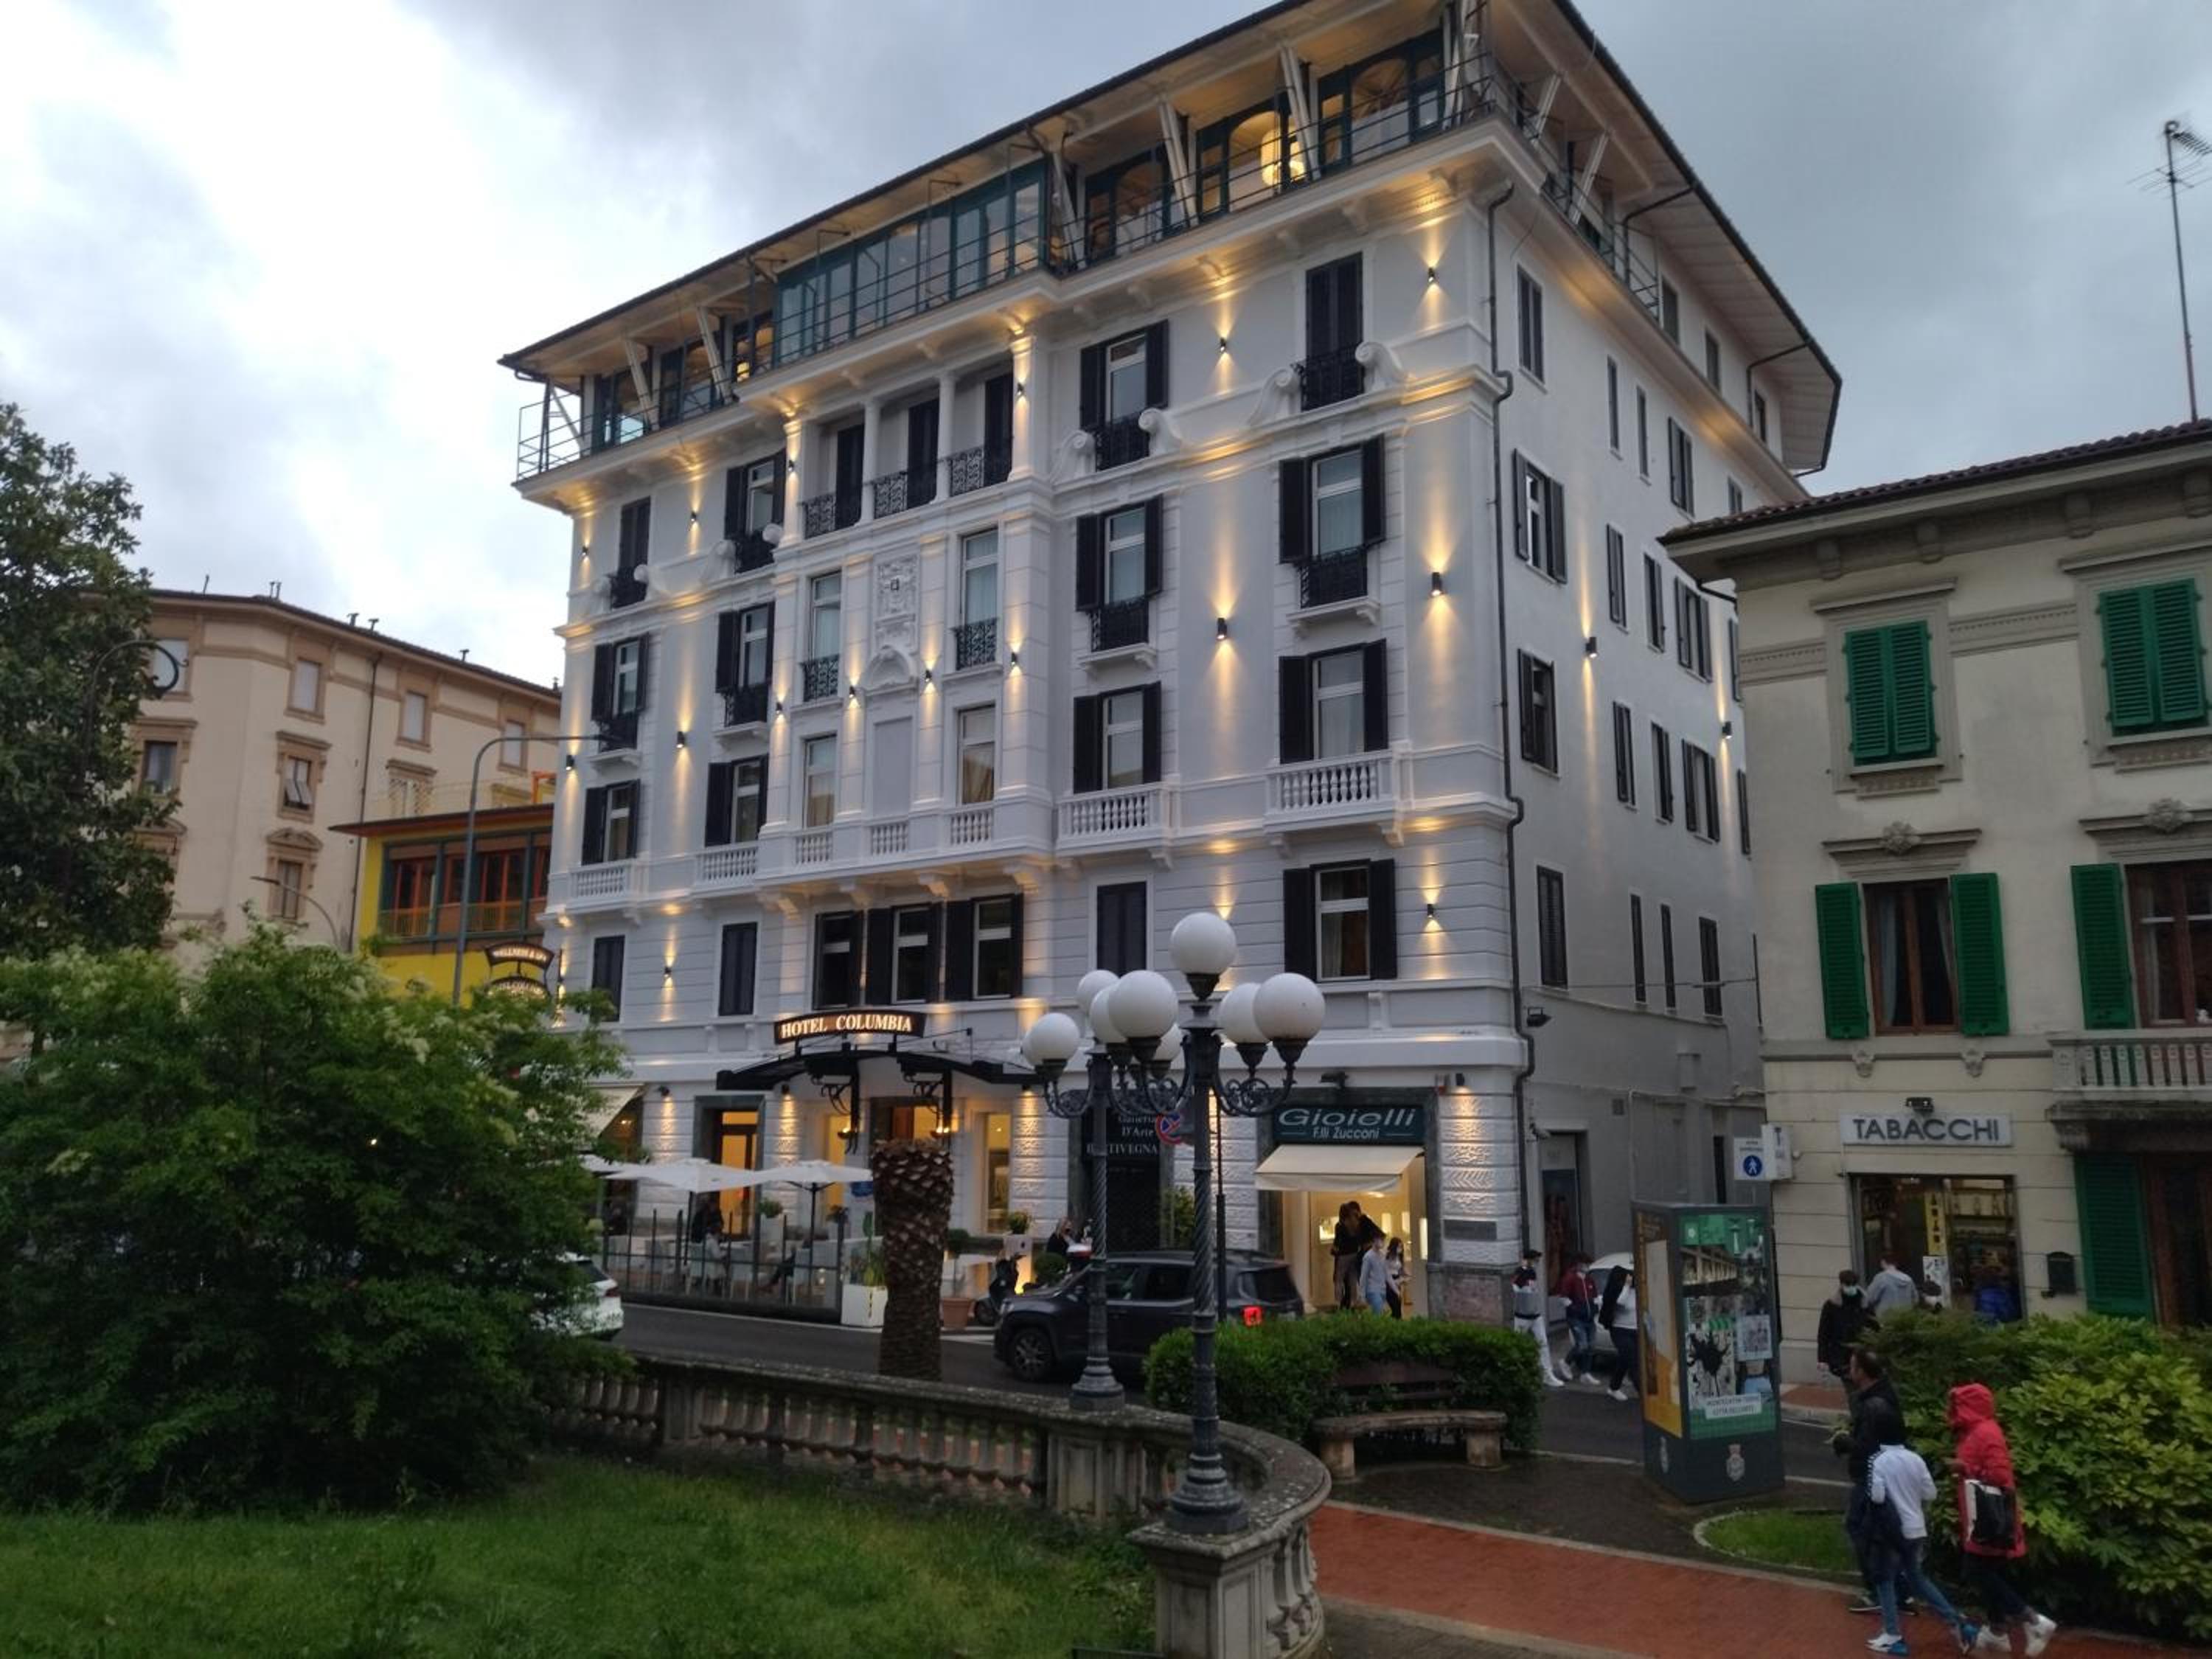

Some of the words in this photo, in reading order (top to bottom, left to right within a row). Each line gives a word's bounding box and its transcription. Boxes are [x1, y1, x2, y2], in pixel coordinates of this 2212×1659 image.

[780, 1018, 827, 1039] HOTEL
[835, 1014, 912, 1032] COLUMBIA
[1278, 1107, 1416, 1127] Gioielli
[1332, 1127, 1380, 1139] Zucconi
[1852, 1118, 1999, 1141] TABACCHI
[1086, 1143, 1158, 1155] BTIVEGNA
